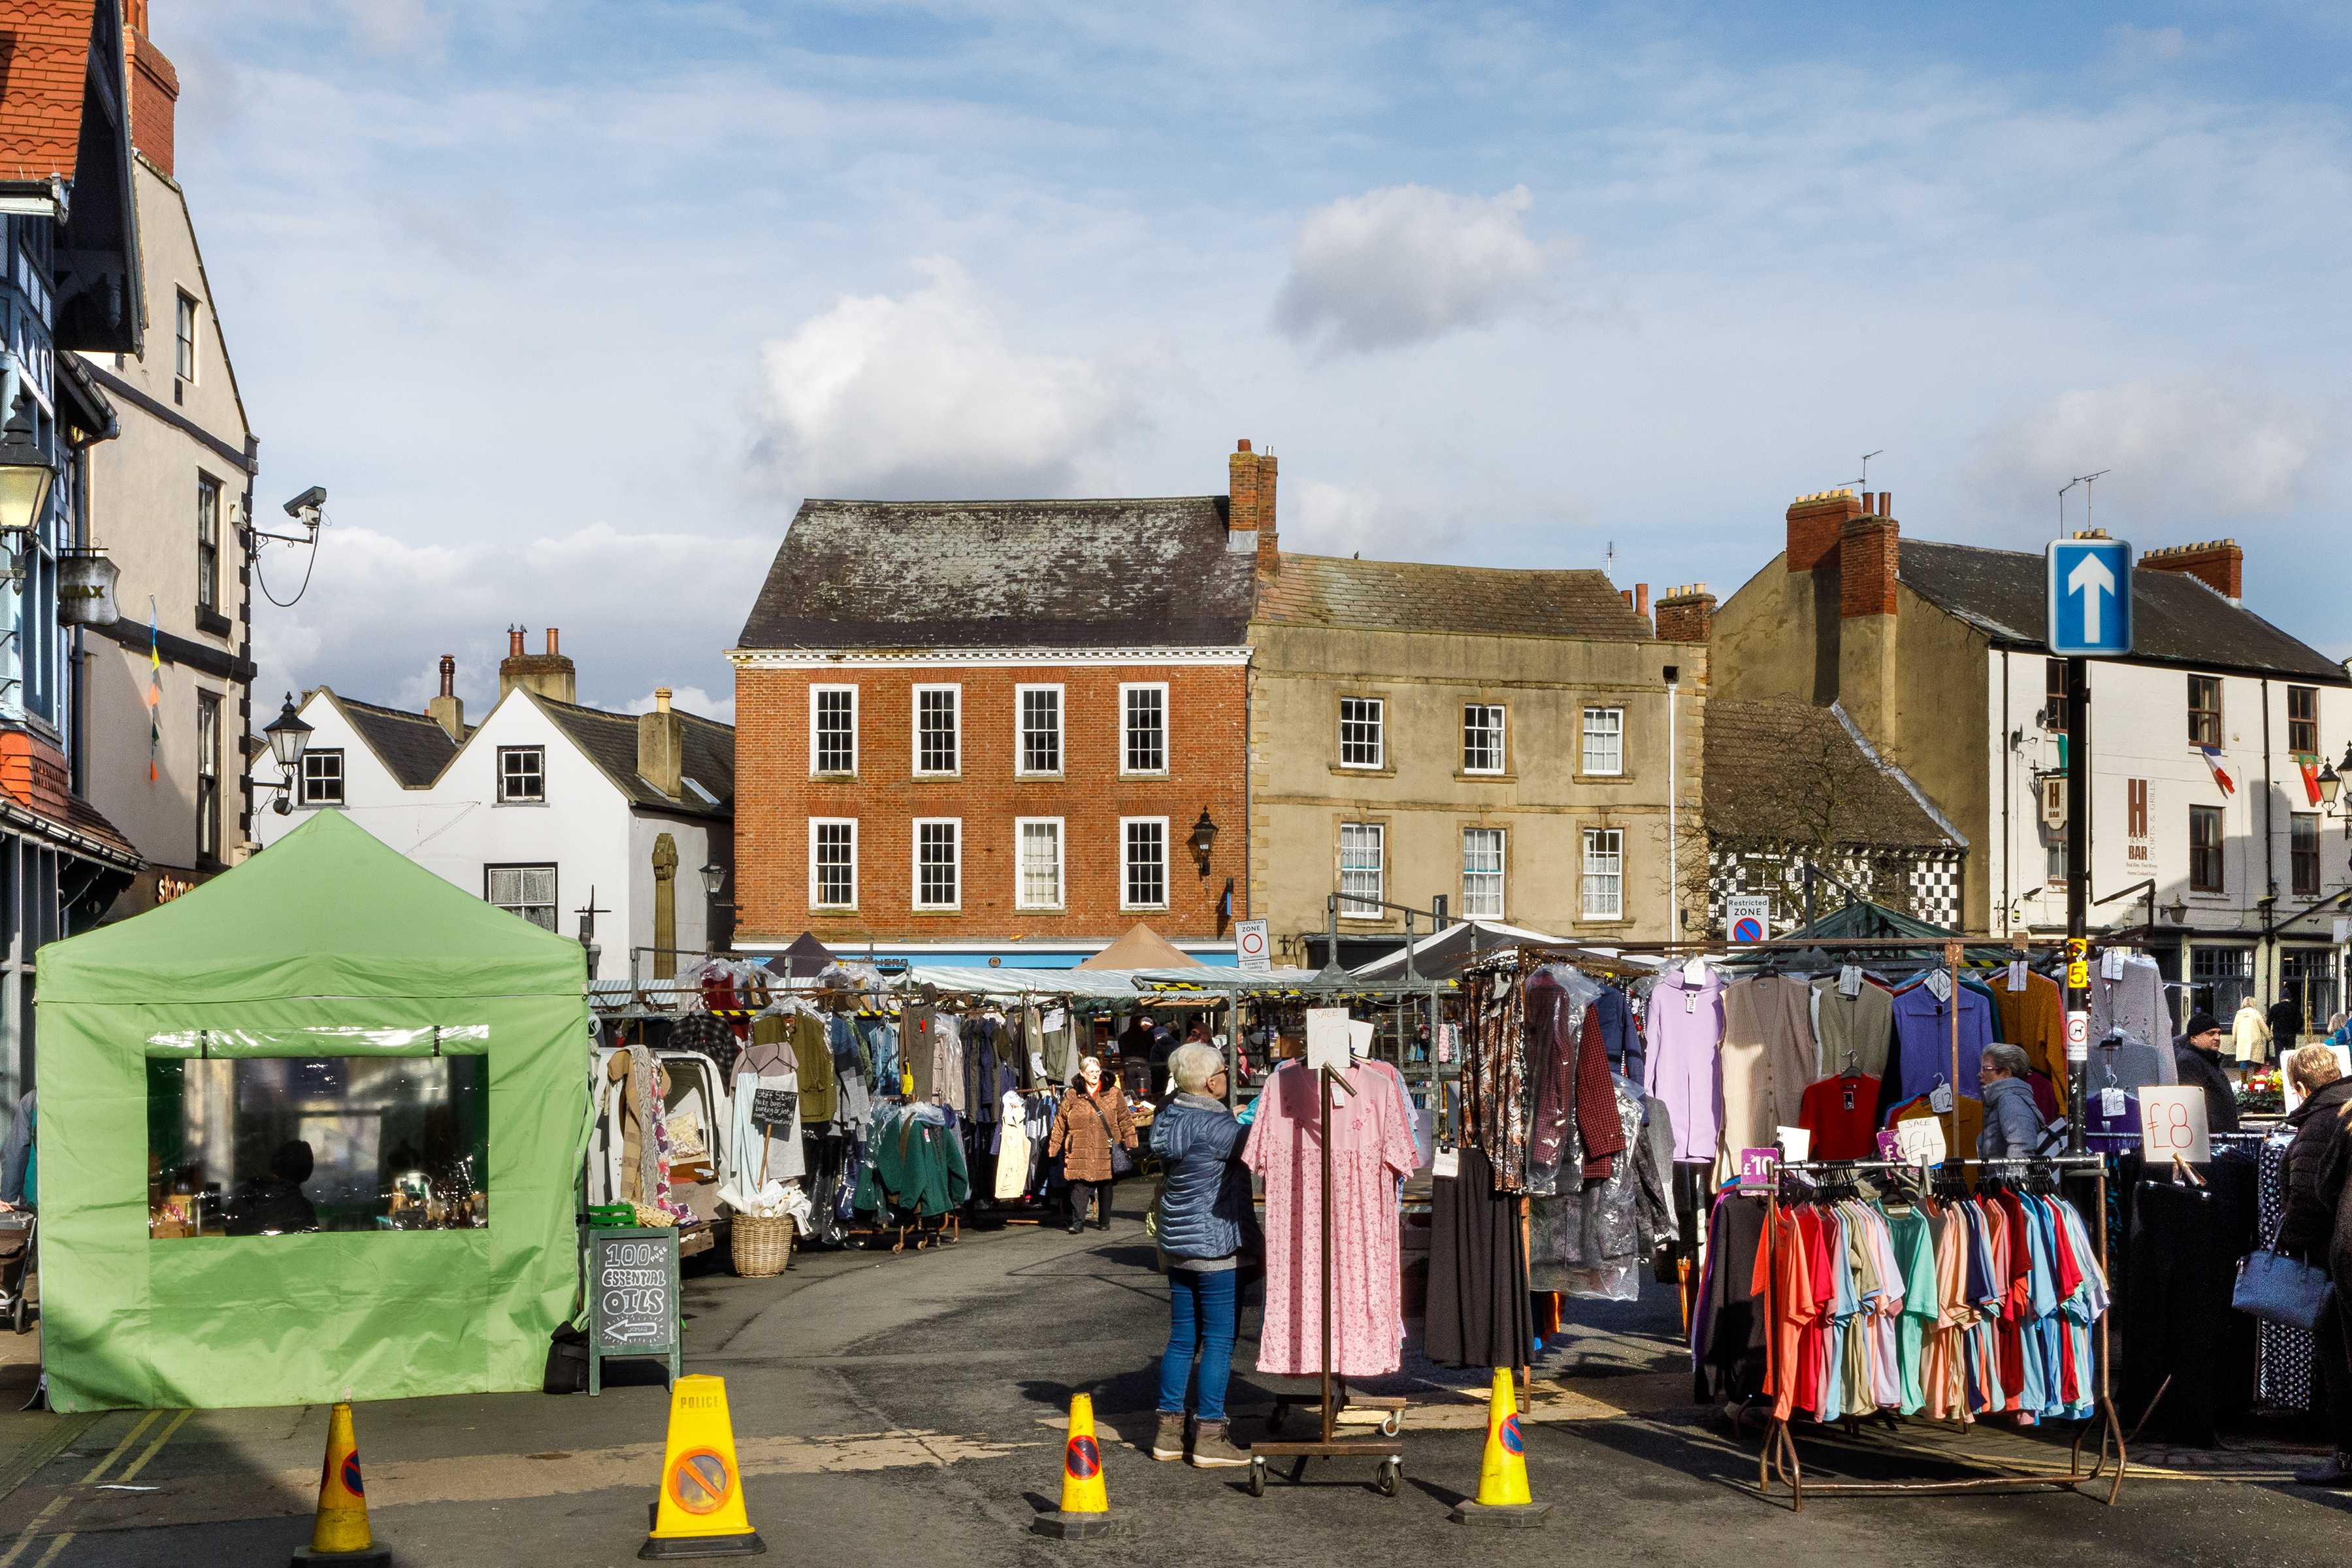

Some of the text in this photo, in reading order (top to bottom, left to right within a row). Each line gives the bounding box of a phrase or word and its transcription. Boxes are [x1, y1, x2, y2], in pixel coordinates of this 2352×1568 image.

[57, 585, 105, 598] IFAX
[2049, 783, 2059, 808] H
[2128, 779, 2148, 838] H
[2129, 845, 2148, 860] BAR
[2070, 966, 2084, 985] 5
[1313, 1009, 1339, 1021] SALE
[1311, 1025, 1348, 1067] £5
[755, 1098, 769, 1107] Make
[770, 1099, 782, 1109] bags
[757, 1090, 796, 1103] Stiff Stuff
[1933, 1092, 1953, 1111] £12
[2104, 1095, 2124, 1115] £15
[755, 1105, 774, 1116] bunting
[778, 1107, 789, 1116] just
[1905, 1119, 1932, 1128] SALE
[2148, 1103, 2193, 1149] £8
[1904, 1131, 1942, 1162] £4
[650, 1246, 668, 1262] PURE
[602, 1268, 666, 1288] ESSENTIAL
[602, 1288, 664, 1315] OILS
[681, 1396, 719, 1409] POLICE
